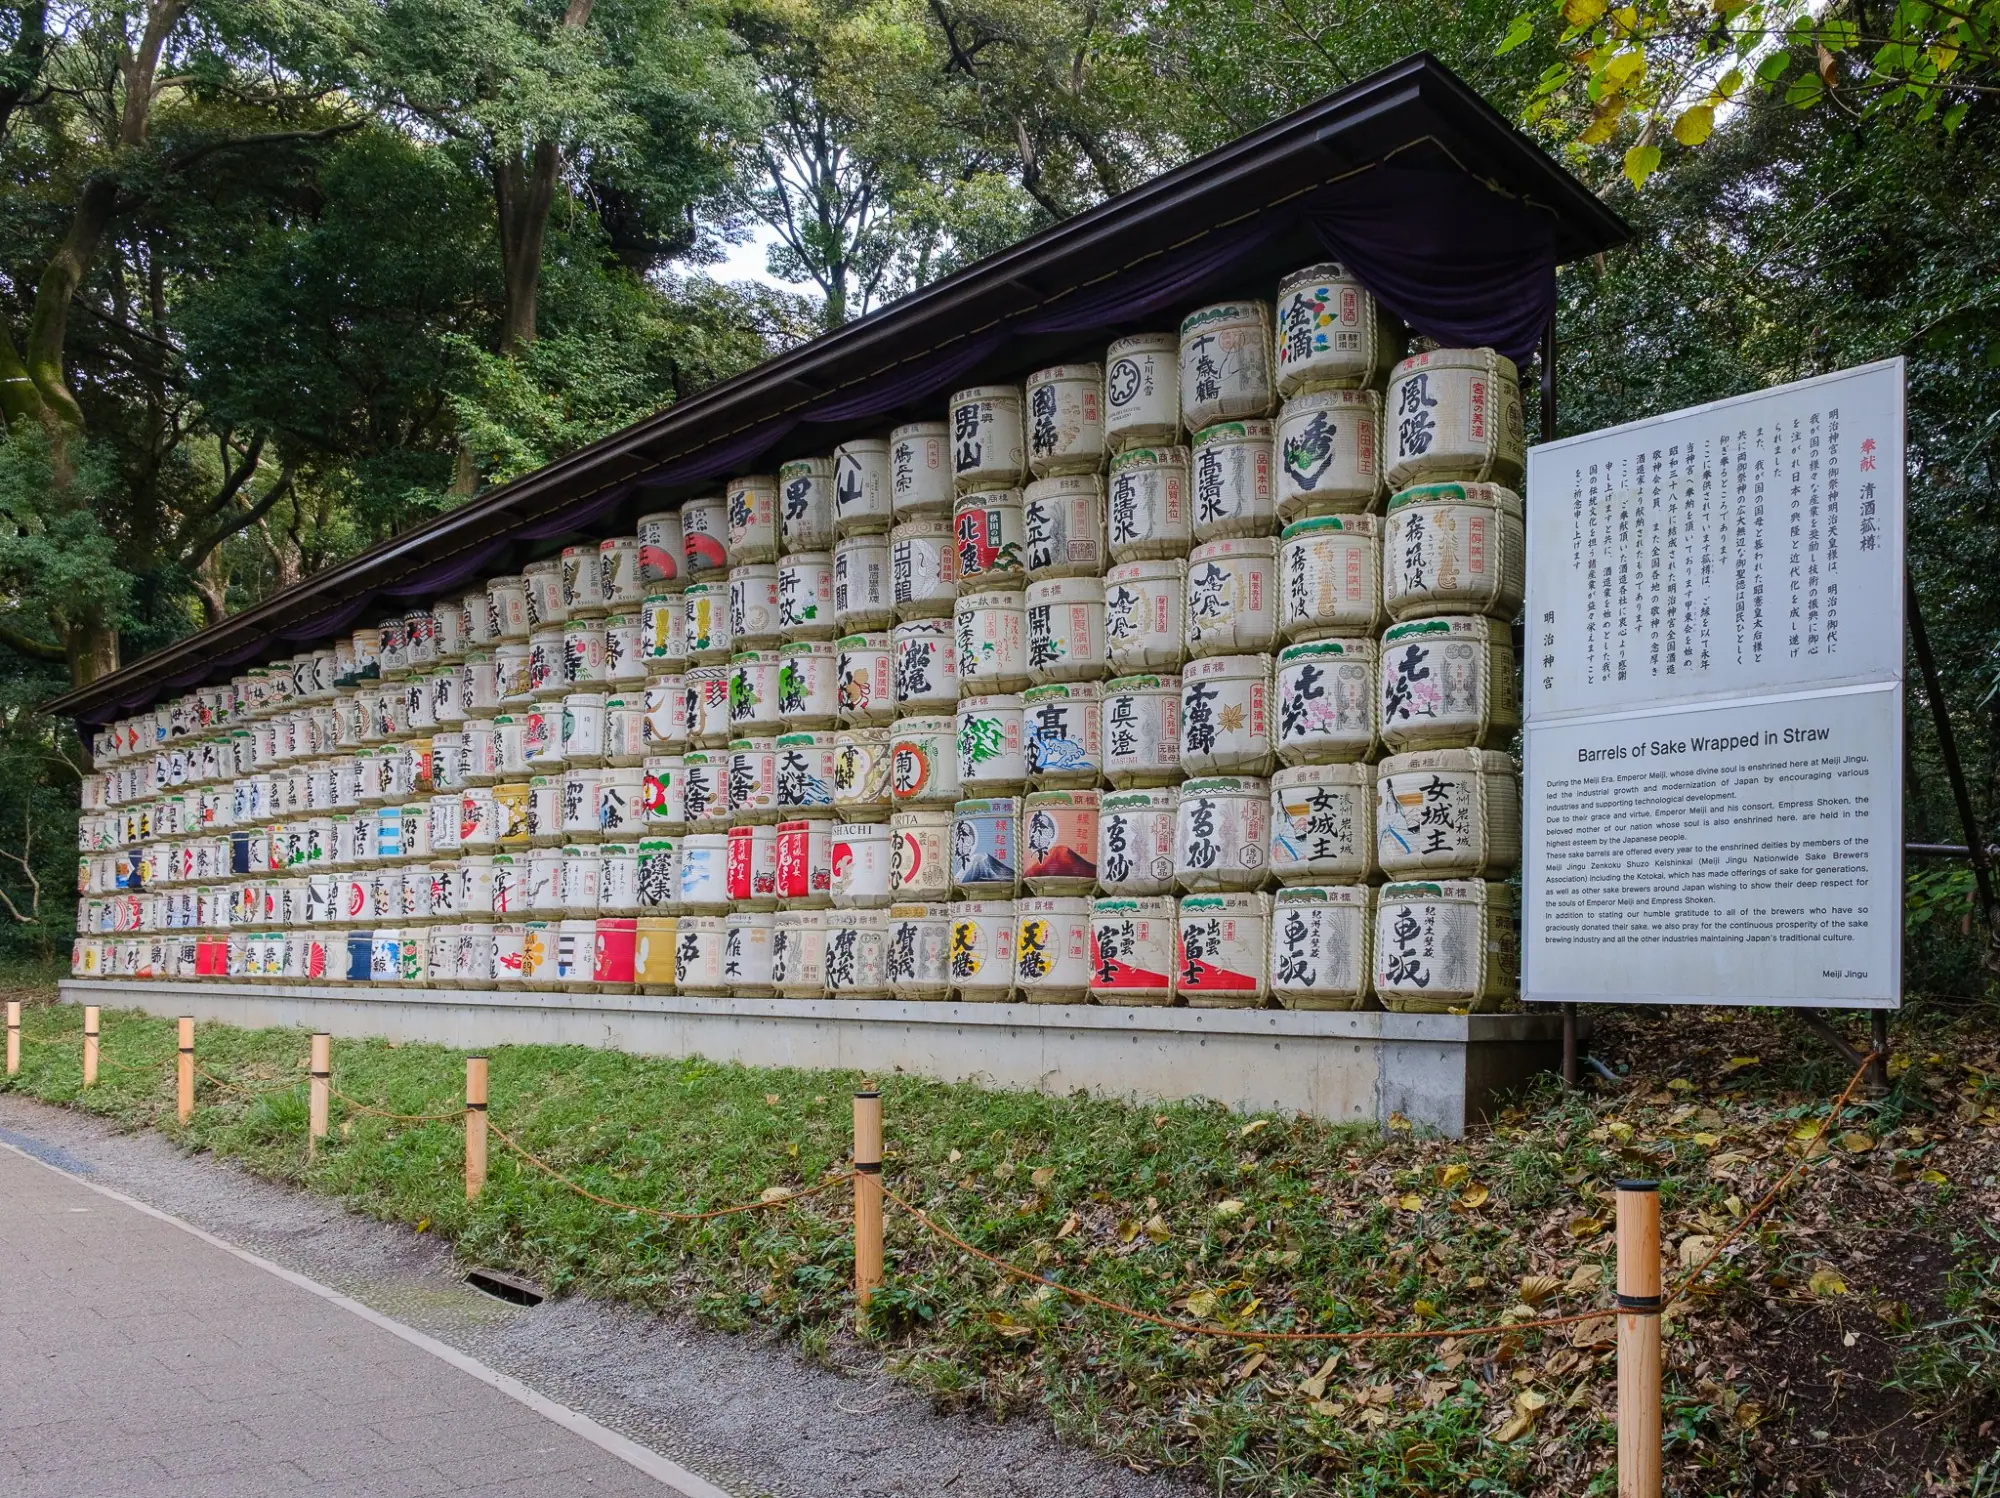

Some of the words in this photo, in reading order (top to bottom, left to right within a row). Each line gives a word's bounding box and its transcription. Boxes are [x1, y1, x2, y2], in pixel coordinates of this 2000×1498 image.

[955, 404, 982, 473] 男山
[1860, 438, 1876, 472] 奉献
[1026, 502, 1051, 571] 太平山
[1543, 610, 1554, 690] 明治神宮
[1578, 745, 1627, 762] Barrels
[1631, 742, 1646, 757] of
[1650, 740, 1686, 755] Sake
[1690, 731, 1759, 752] Wrapped
[1764, 730, 1778, 745] in
[1783, 728, 1830, 743] Straw
[896, 751, 913, 791] 菊水
[1720, 765, 1737, 773] soul
[1747, 761, 1787, 771] enshrined
[1820, 756, 1840, 765] Meiji
[1576, 788, 1609, 796] industrial
[1613, 786, 1638, 795] growth
[1643, 784, 1657, 792] and
[1661, 780, 1716, 790] modernization
[1720, 778, 1729, 786] of
[1778, 772, 1831, 781] encouraging
[1837, 769, 1869, 777] various
[1419, 774, 1454, 855] 女城主
[1546, 803, 1579, 811] industries
[1595, 799, 1633, 808] supporting
[1634, 795, 1684, 805] technological
[1305, 788, 1338, 862] 女城主
[1544, 936, 1572, 944] brewing
[1700, 934, 1744, 942] maintaining
[1822, 970, 1842, 978] Meiji
[1844, 970, 1868, 979] Jingu
